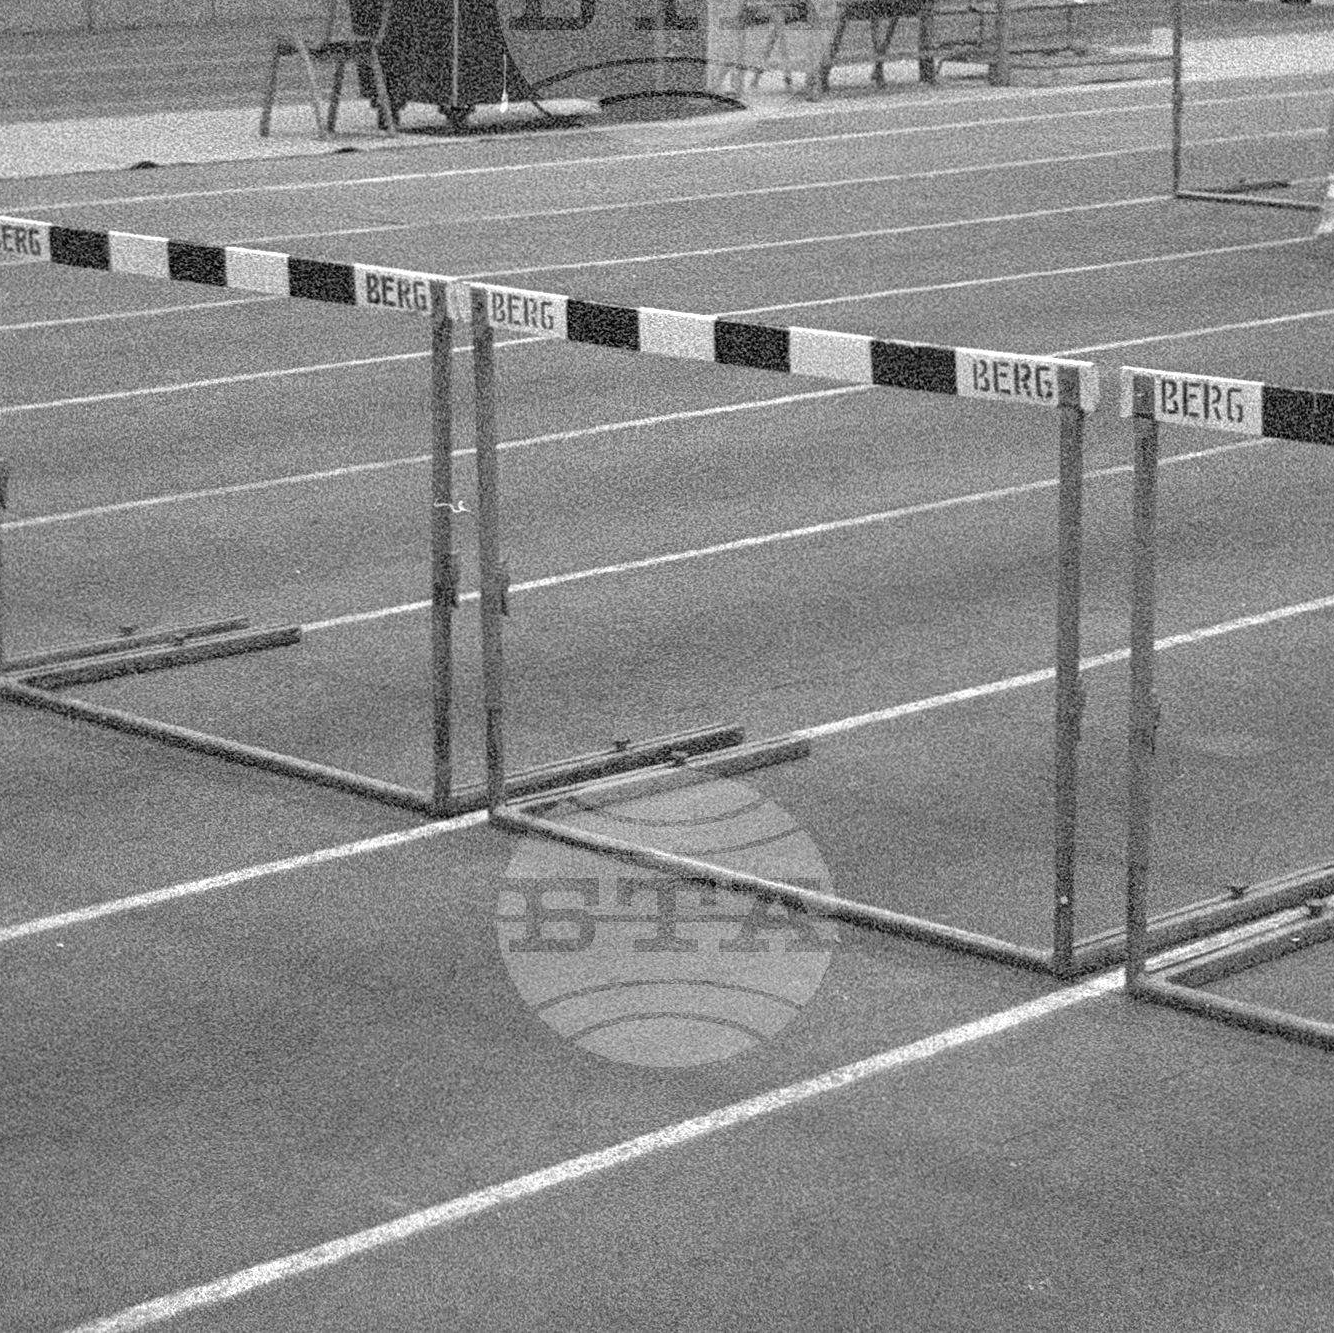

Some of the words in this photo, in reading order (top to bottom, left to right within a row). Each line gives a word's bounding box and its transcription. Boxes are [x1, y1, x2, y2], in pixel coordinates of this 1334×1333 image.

[365, 273, 428, 311] BERG
[490, 291, 555, 330] BERG
[971, 359, 1054, 399] BERG
[1160, 379, 1244, 423] BERG
